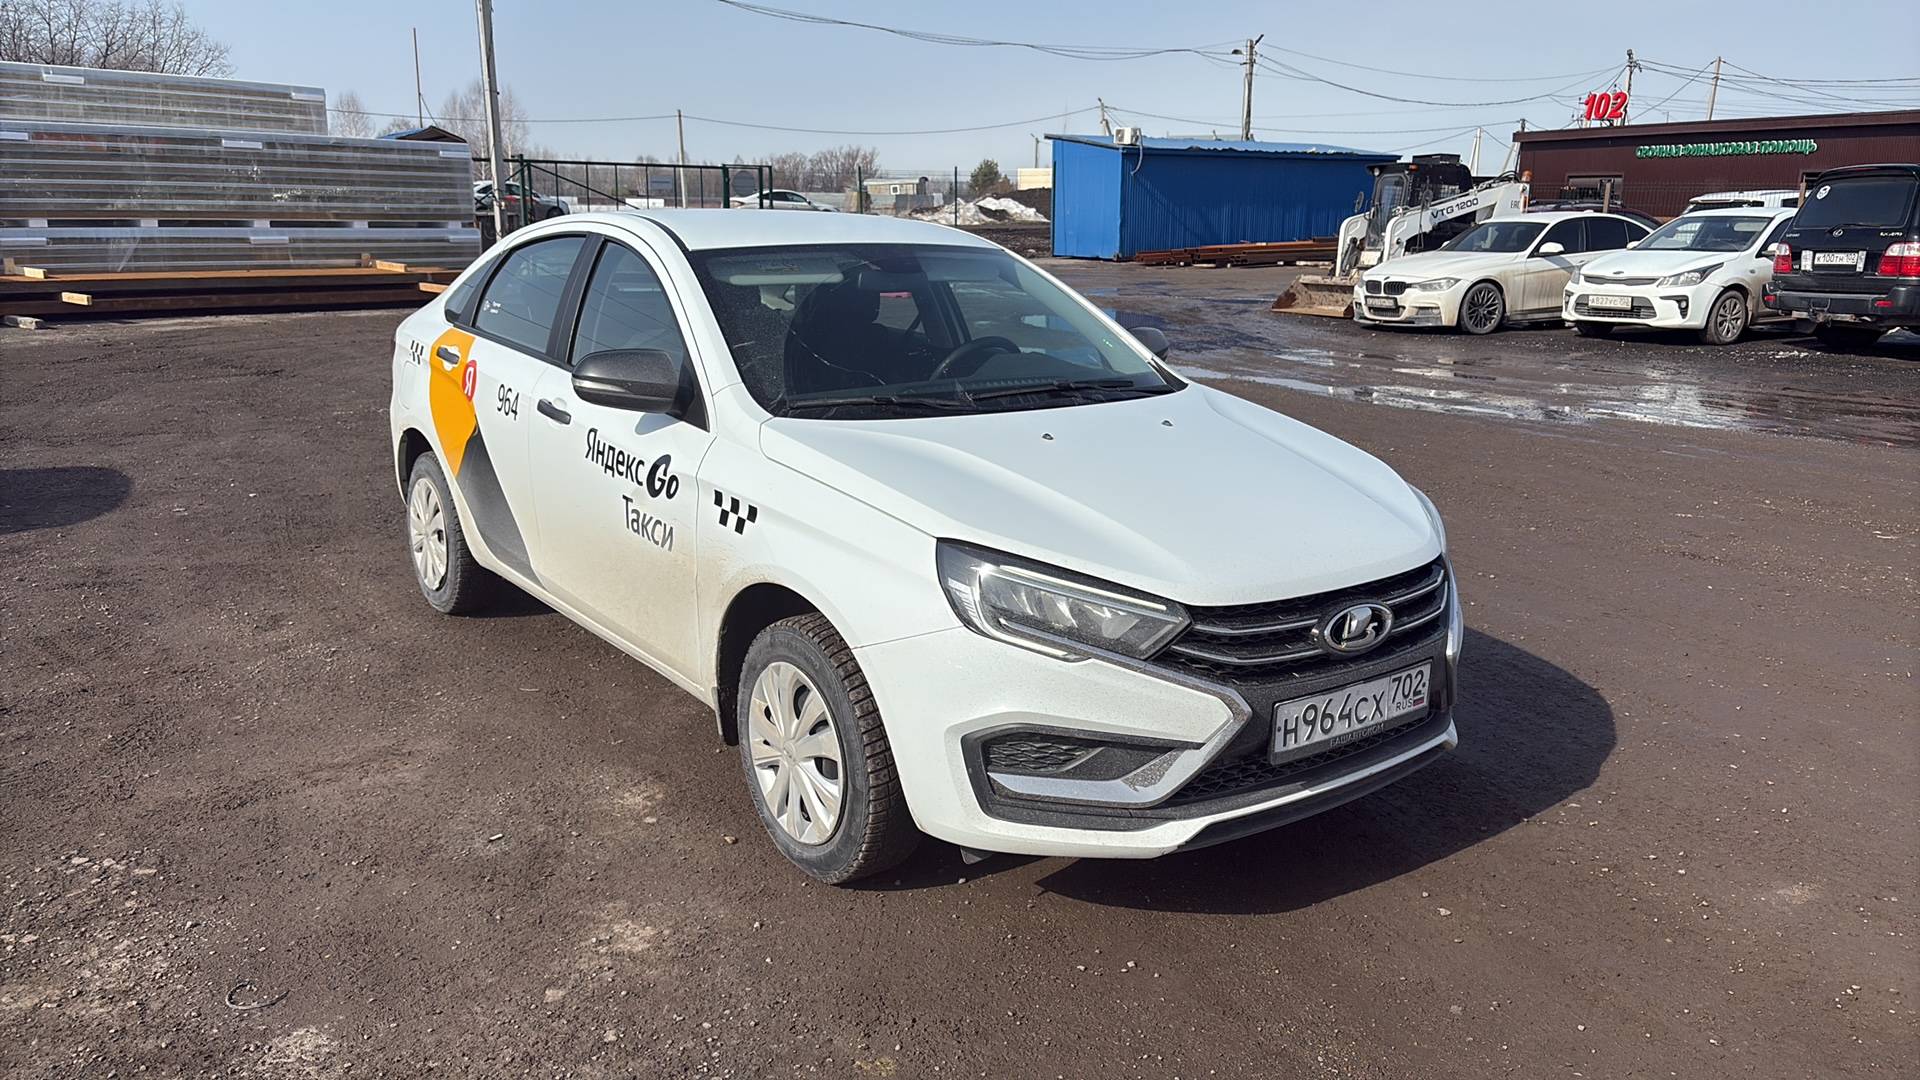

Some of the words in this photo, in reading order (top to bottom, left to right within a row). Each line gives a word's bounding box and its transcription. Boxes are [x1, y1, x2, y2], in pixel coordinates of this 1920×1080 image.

[1584, 92, 1628, 120] 102
[1760, 139, 1818, 155] ПОМОЩЬ
[1431, 206, 1455, 219] VTG
[1456, 198, 1479, 212] 1200
[463, 364, 475, 398] Я
[497, 383, 519, 421] 964
[585, 427, 645, 487] Яндекс
[646, 454, 680, 501] Go
[622, 494, 675, 553] Такси
[1391, 669, 1426, 705] 702
[1395, 699, 1413, 711] RUS
